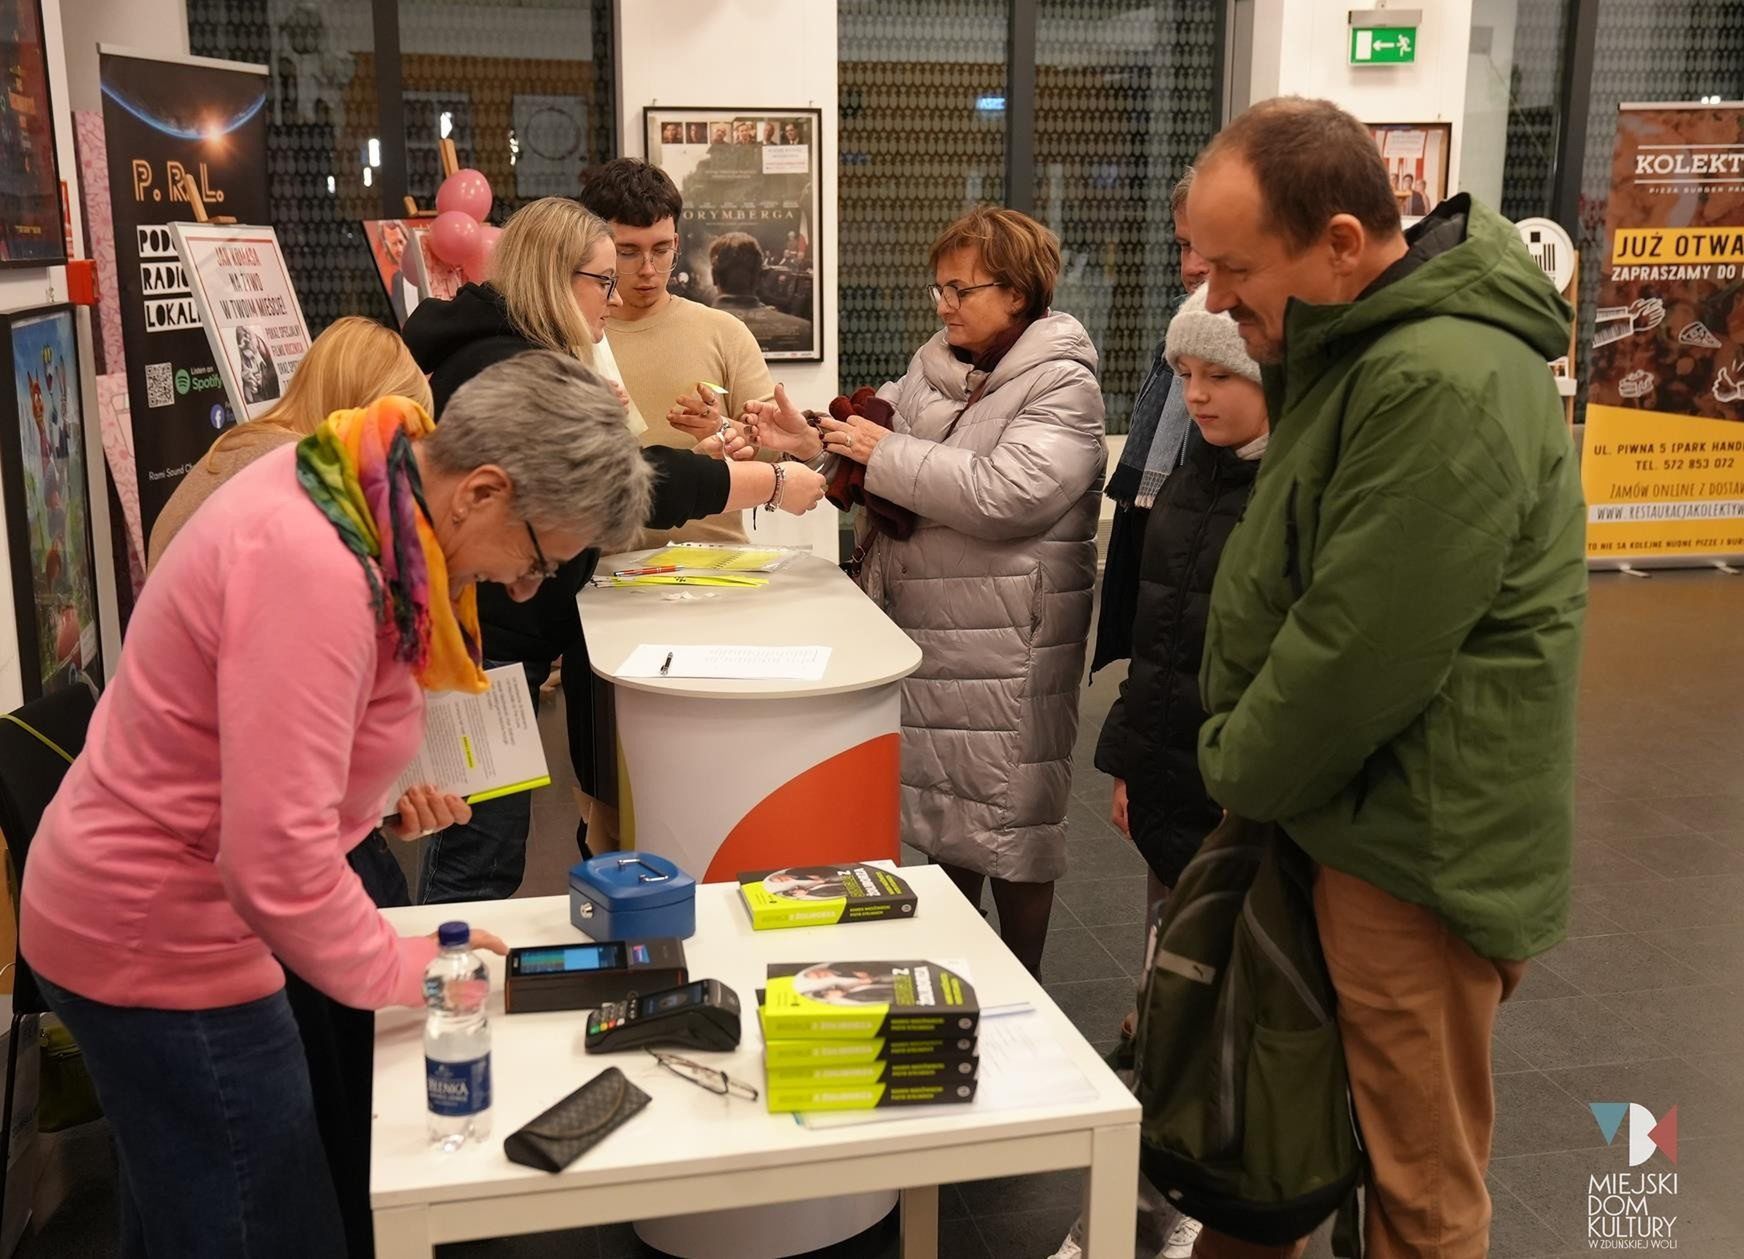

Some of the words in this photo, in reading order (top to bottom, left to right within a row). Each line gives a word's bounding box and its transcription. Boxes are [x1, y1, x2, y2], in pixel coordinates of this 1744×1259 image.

[1635, 154, 1744, 174] KOLEKT
[132, 159, 225, 203] P.RL.
[683, 209, 794, 220] ORYMBERGA
[1617, 232, 1663, 258] JUŻ
[1675, 234, 1744, 257] OTWA
[1611, 265, 1711, 281] ZAPRASZAMY
[1716, 264, 1736, 279] DO
[191, 374, 222, 391] Spotify
[1617, 443, 1654, 454] PIWNA
[1664, 459, 1684, 470] 572
[1688, 458, 1709, 469] 853
[1714, 457, 1735, 468] 072
[1609, 481, 1649, 499] ZAMÓW
[1653, 482, 1694, 497] ONLINE
